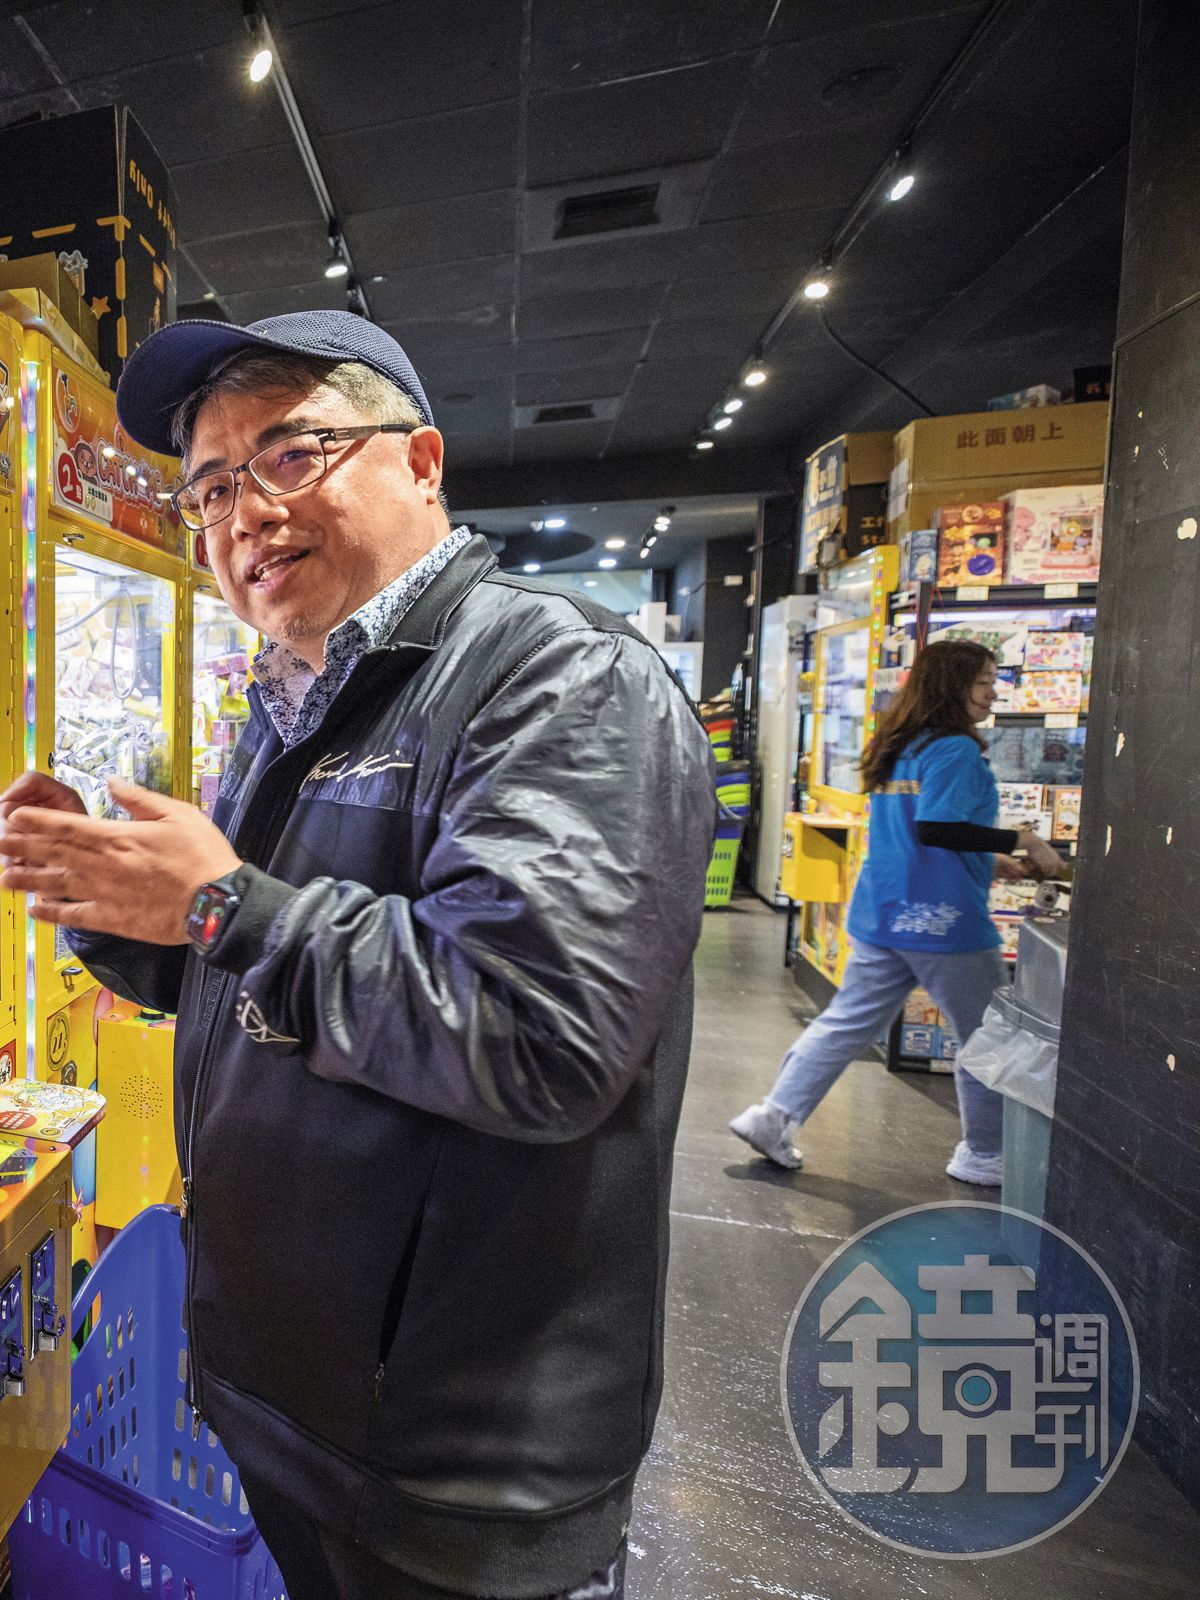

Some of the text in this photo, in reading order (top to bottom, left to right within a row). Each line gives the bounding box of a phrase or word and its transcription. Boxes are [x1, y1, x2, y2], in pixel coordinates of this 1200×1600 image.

[956, 420, 1064, 449] 此面朝上
[62, 463, 73, 493] 2
